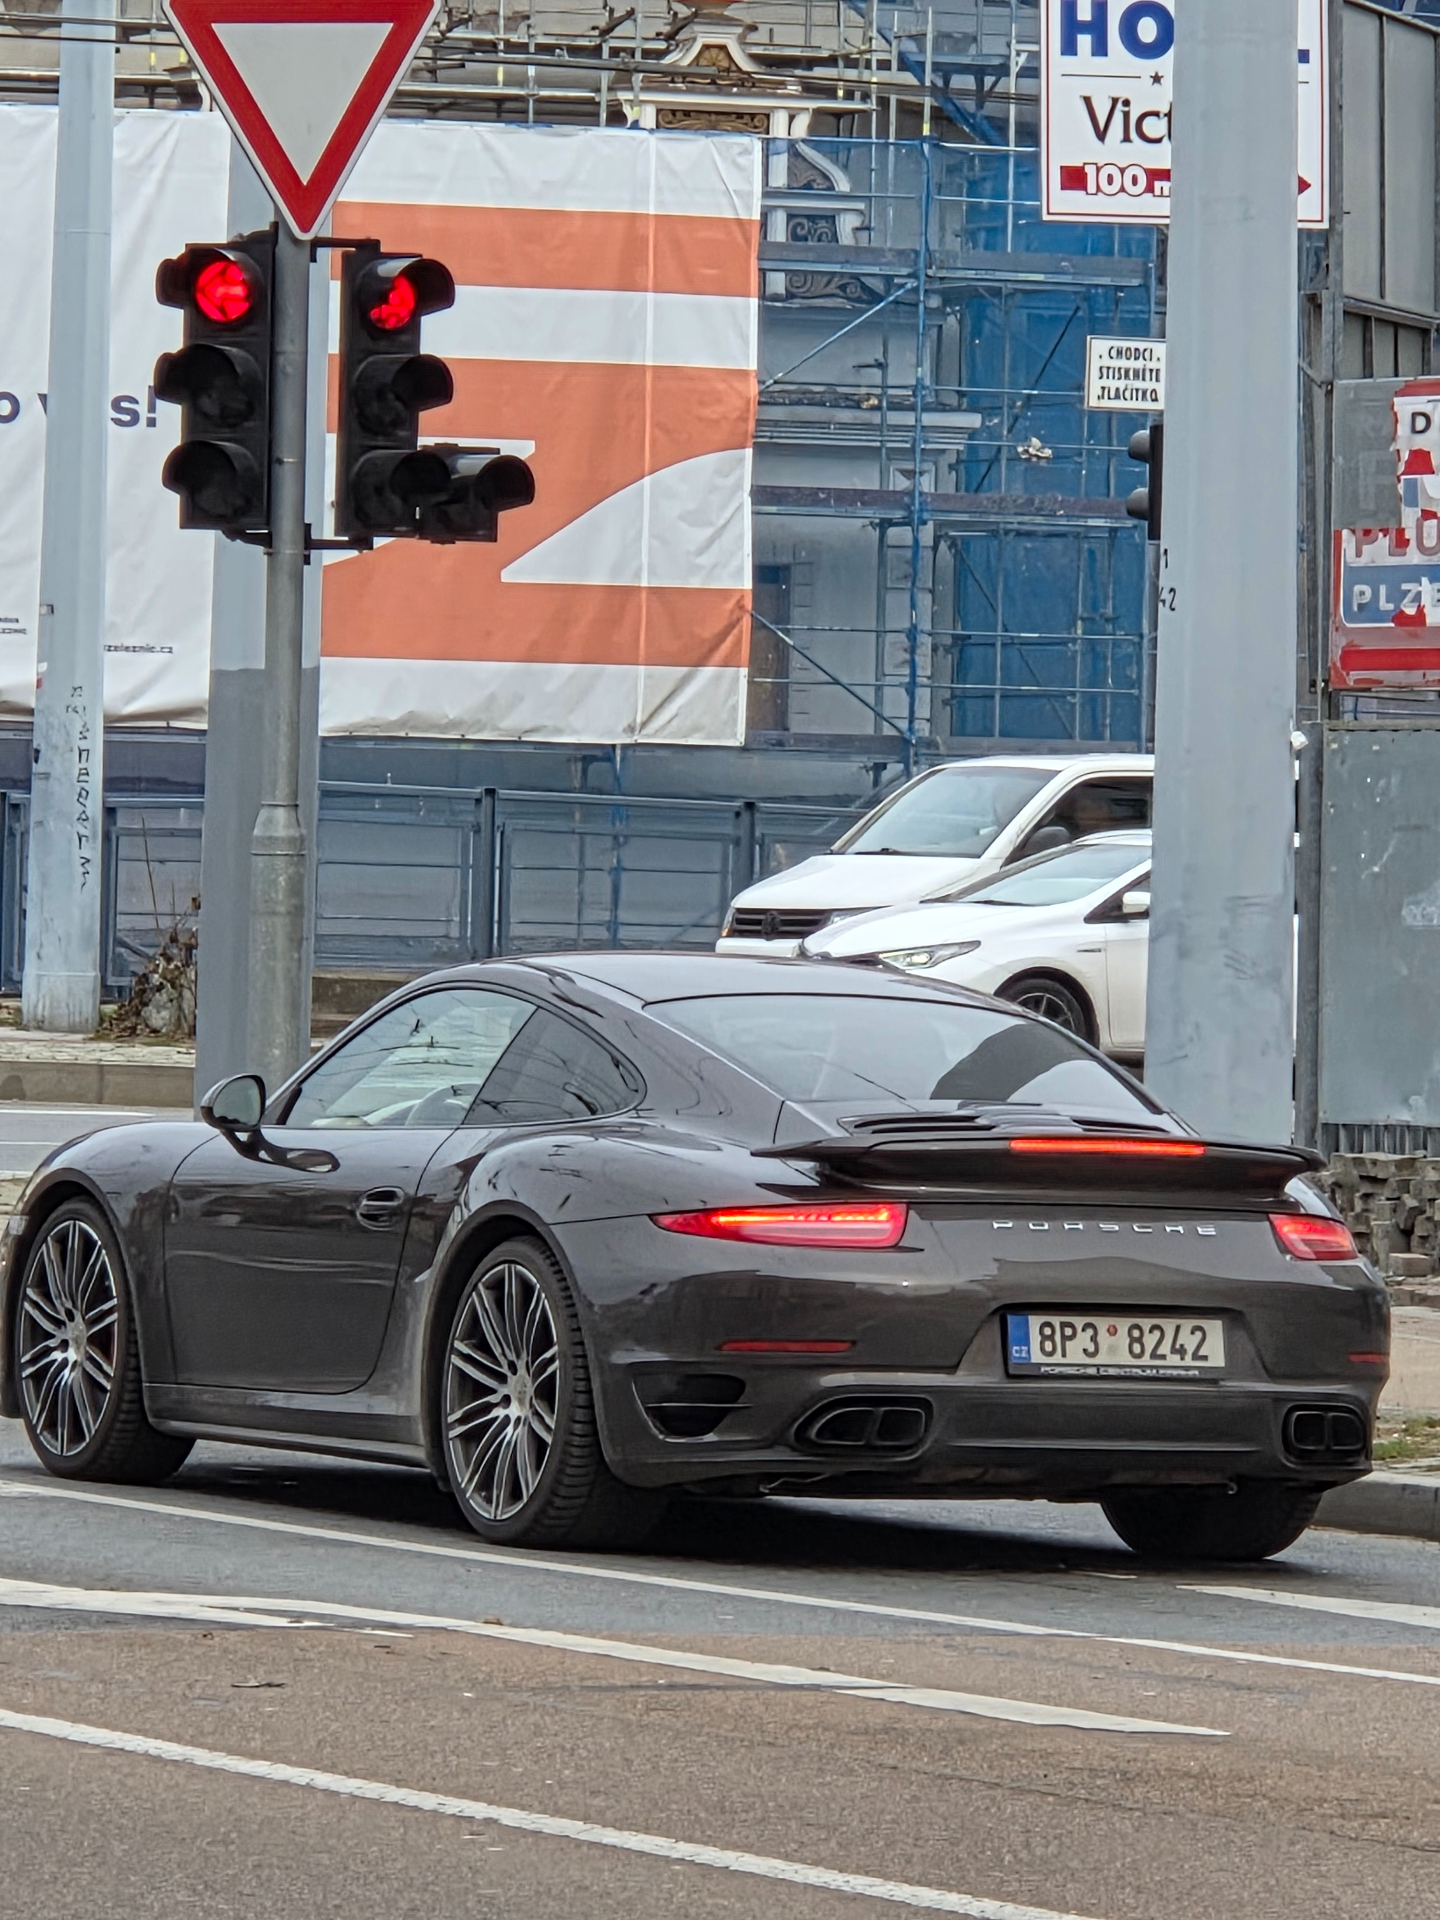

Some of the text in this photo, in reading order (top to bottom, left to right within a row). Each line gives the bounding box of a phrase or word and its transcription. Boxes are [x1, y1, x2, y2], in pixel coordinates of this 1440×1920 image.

[1083, 163, 1148, 197] 100
[1108, 345, 1154, 362] CHODCI
[992, 1219, 1217, 1236] PORSCHE
[1038, 1320, 1210, 1363] 8P3 8242
[1012, 1346, 1029, 1358] CZ
